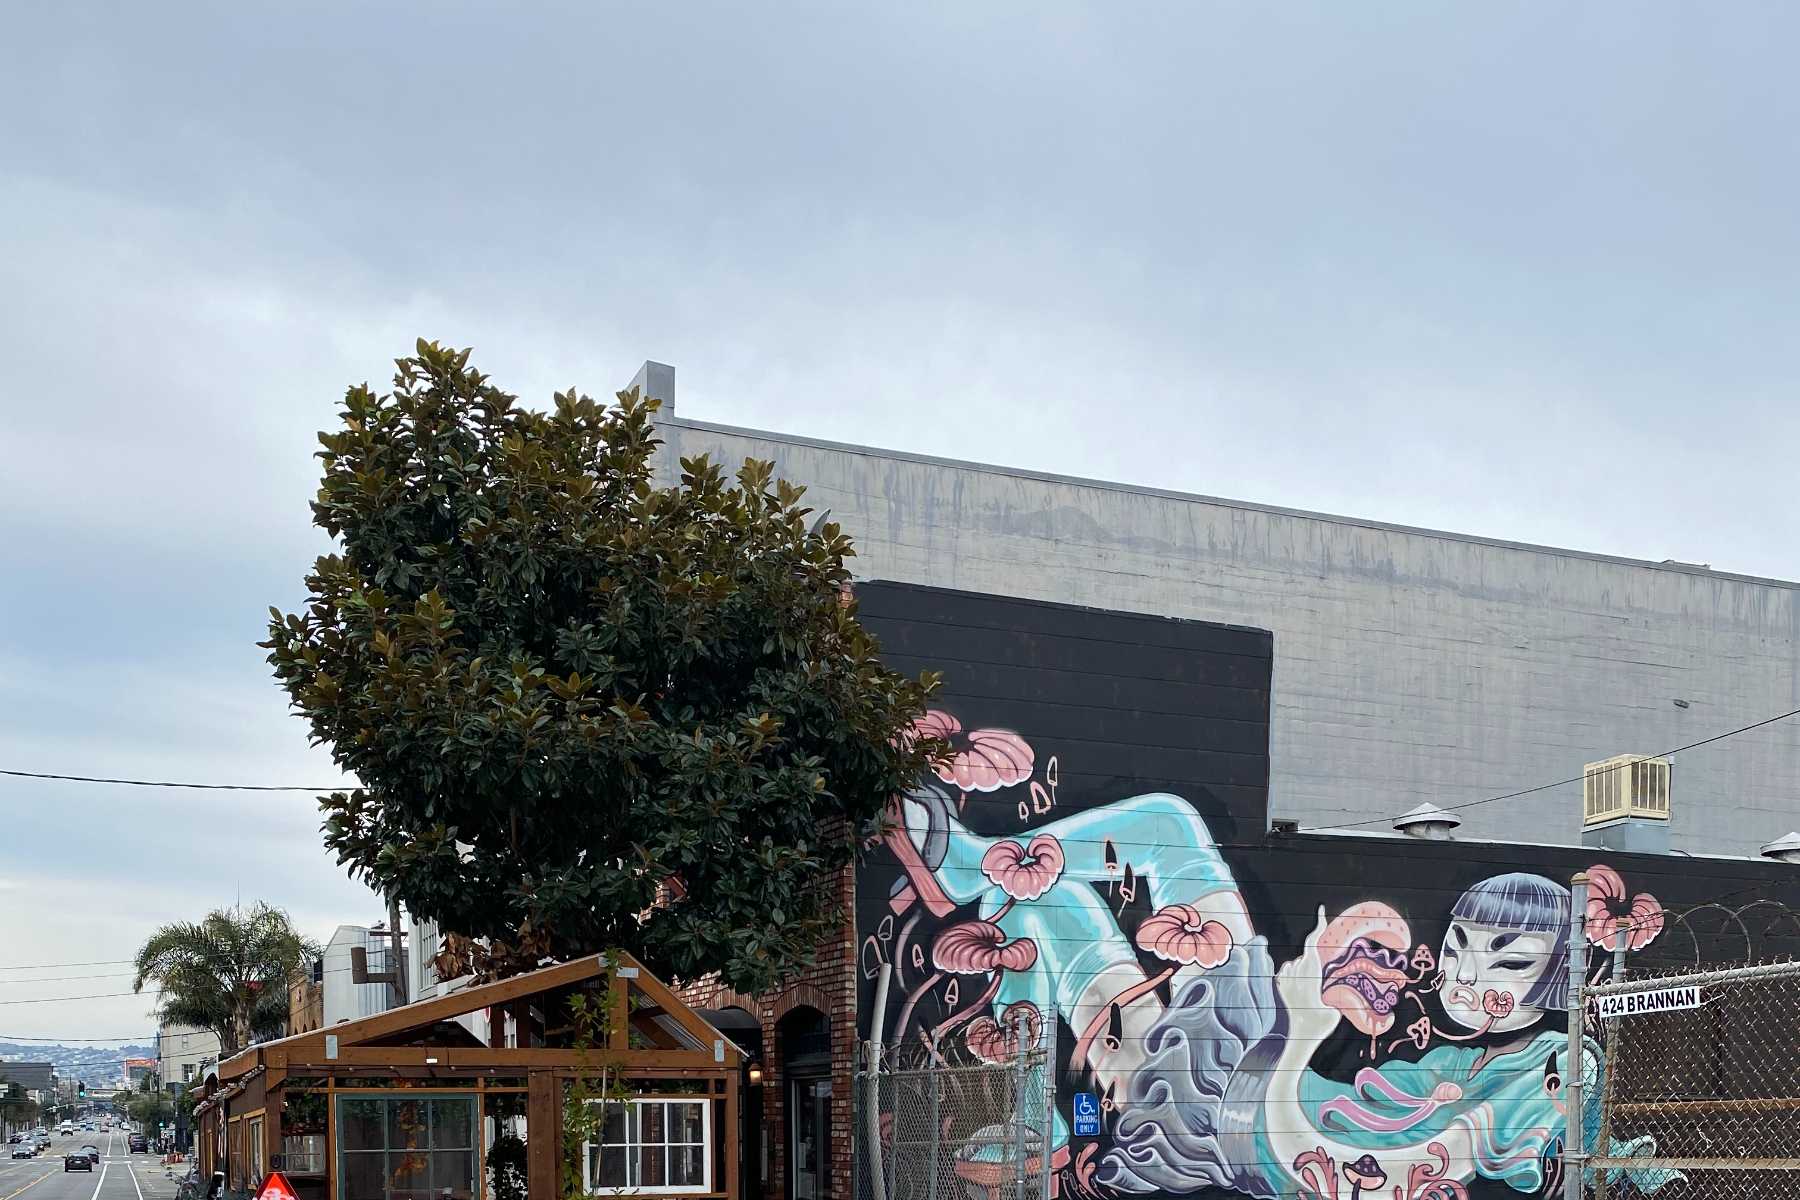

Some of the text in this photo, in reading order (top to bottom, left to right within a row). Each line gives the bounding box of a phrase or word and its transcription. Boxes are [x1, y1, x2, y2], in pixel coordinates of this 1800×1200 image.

[1602, 989, 1696, 1015] 424 BRANNAN
[1076, 1115, 1098, 1124] PARKING
[1079, 1124, 1095, 1133] ONLY
